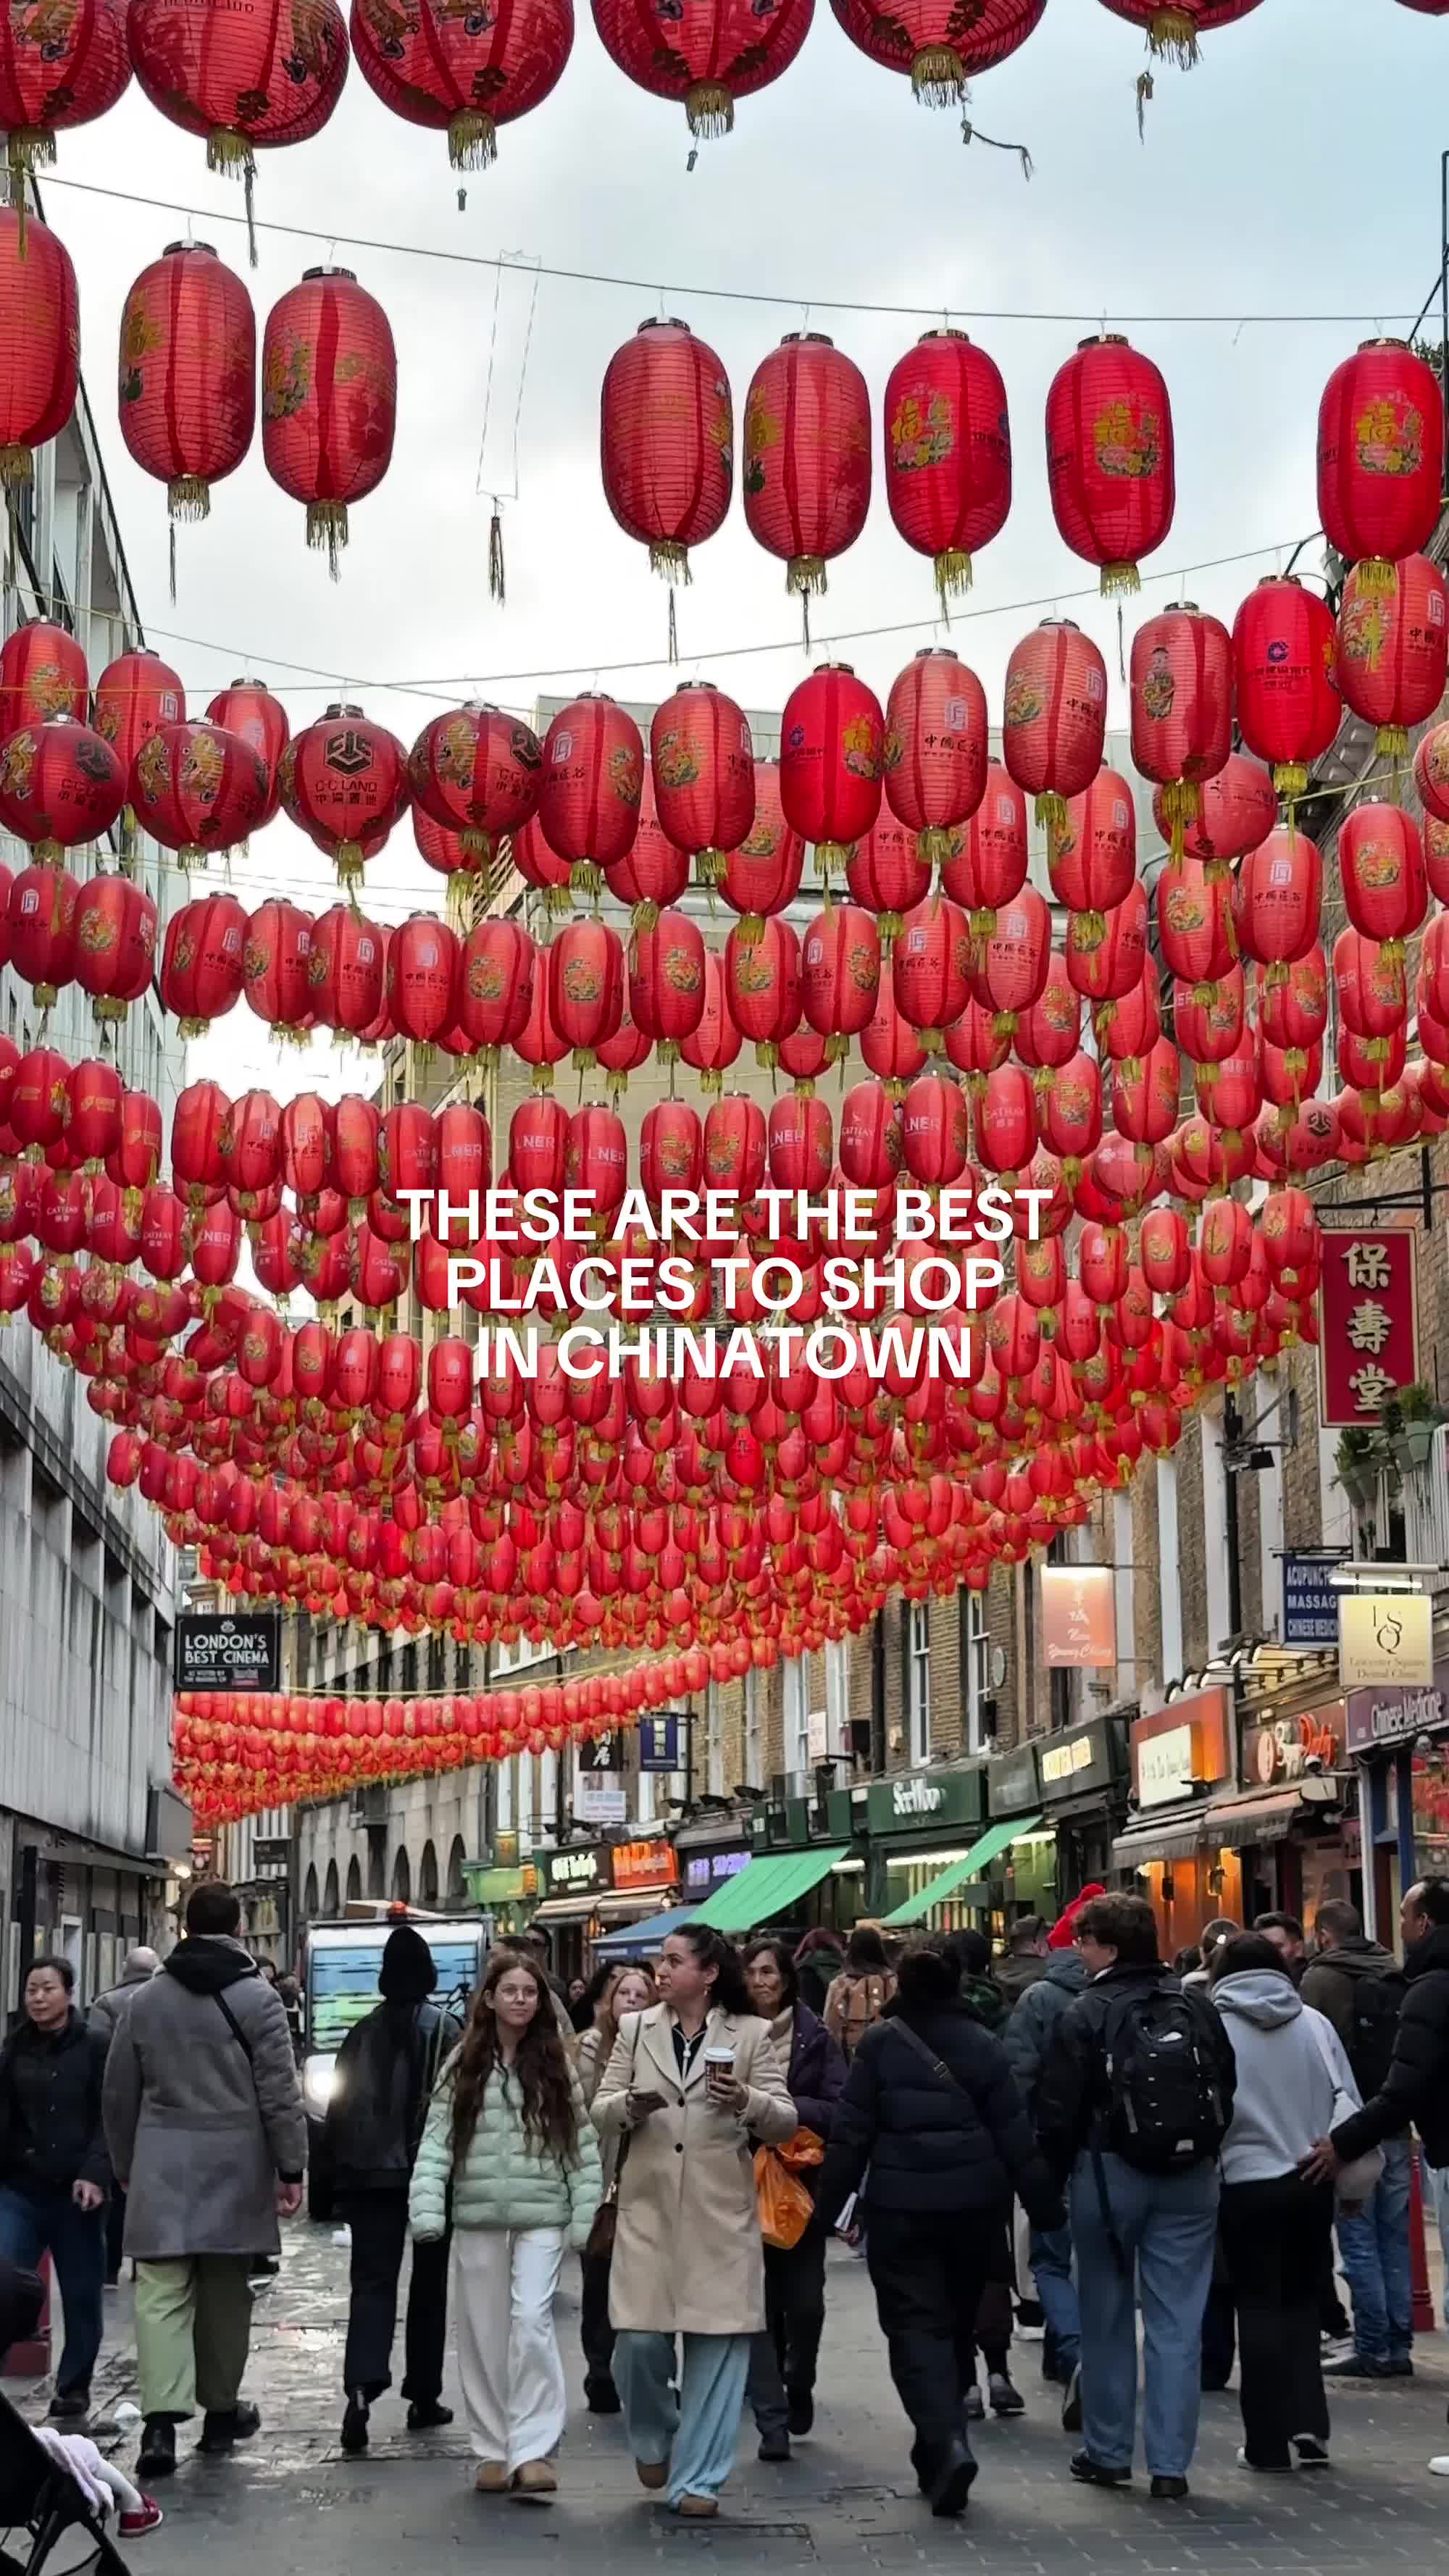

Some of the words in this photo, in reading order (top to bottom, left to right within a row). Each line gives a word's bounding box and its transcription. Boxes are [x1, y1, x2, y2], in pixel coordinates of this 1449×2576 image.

[341, 781, 377, 793] LAND
[515, 1136, 555, 1150] LNER
[588, 1147, 626, 1163] LNER
[1340, 1241, 1398, 1412] 保壽堂
[1287, 1565, 1331, 1587] ACUPUNCT
[1287, 1594, 1337, 1609] MASSAG
[185, 1634, 267, 1649] LONDON'S
[185, 1650, 217, 1664] BEST
[222, 1650, 270, 1664] CINEMA
